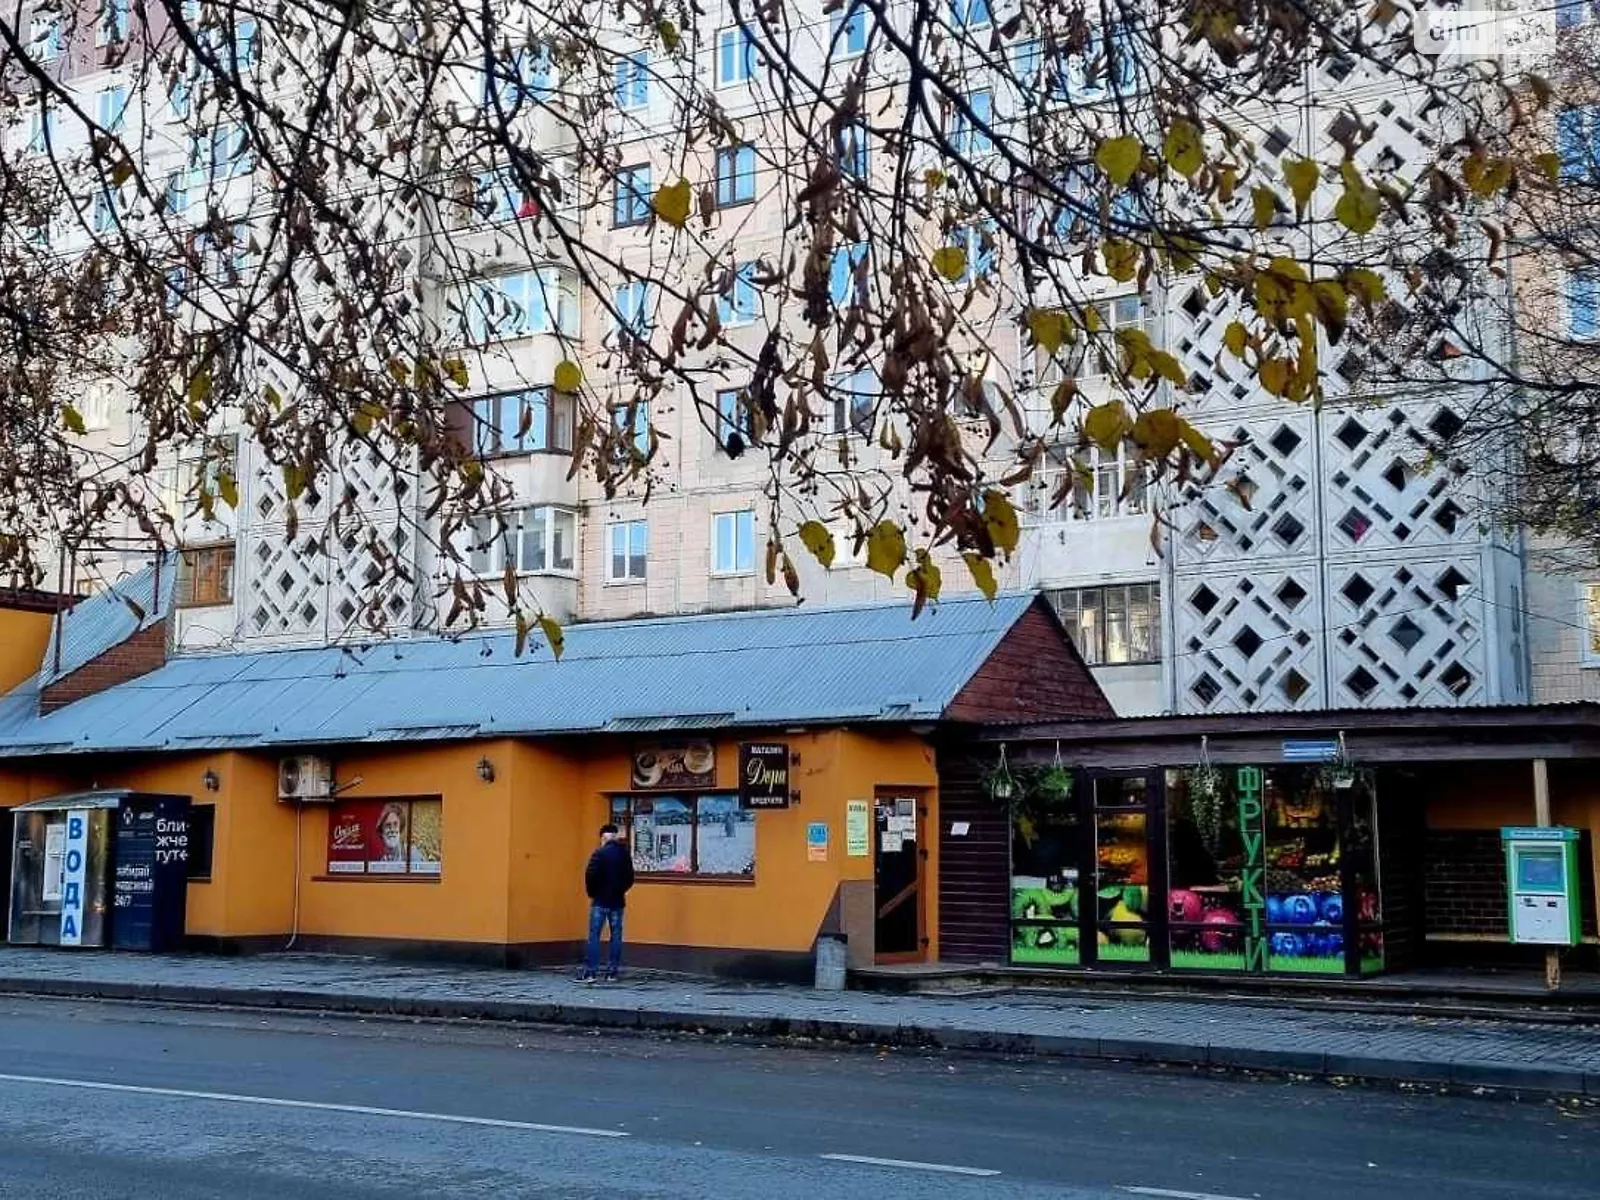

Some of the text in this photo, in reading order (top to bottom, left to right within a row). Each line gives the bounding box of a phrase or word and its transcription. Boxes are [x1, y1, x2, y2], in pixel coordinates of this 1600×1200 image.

[62, 818, 82, 937] ВОДА
[155, 835, 188, 847] жче
[1237, 766, 1269, 972] ФРУКТИ
